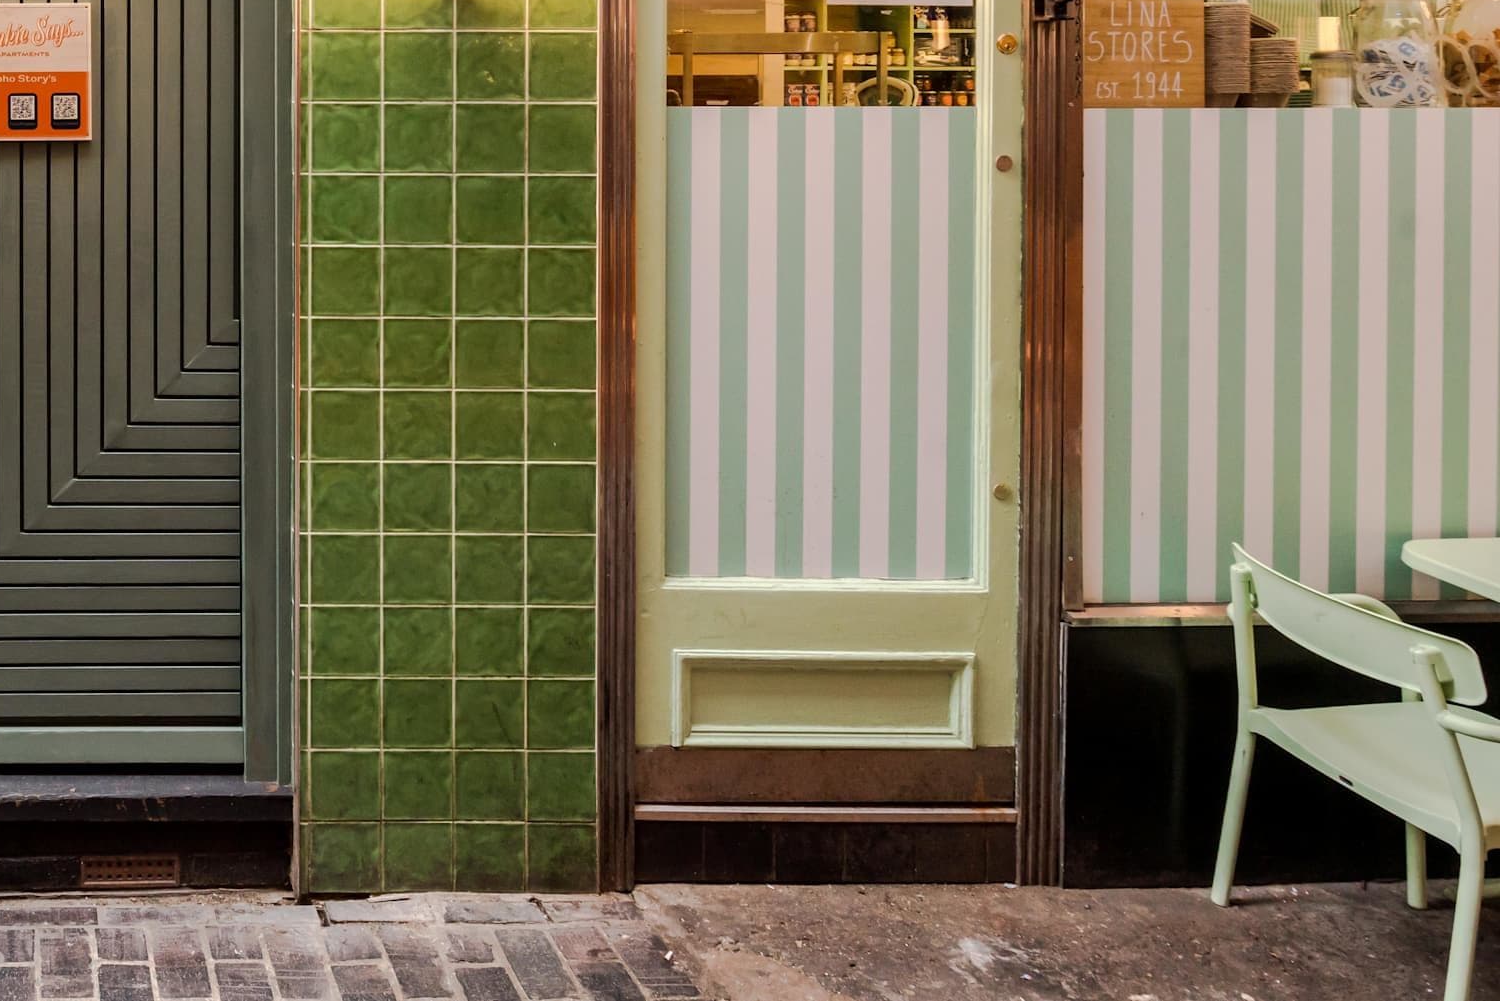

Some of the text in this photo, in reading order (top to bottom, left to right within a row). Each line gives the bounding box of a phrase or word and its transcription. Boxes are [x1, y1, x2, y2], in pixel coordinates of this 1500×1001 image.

[1110, 0, 1172, 28] LINA
[1087, 30, 1193, 64] STORES
[18, 74, 57, 85] Story's
[1132, 72, 1184, 99] 1944
